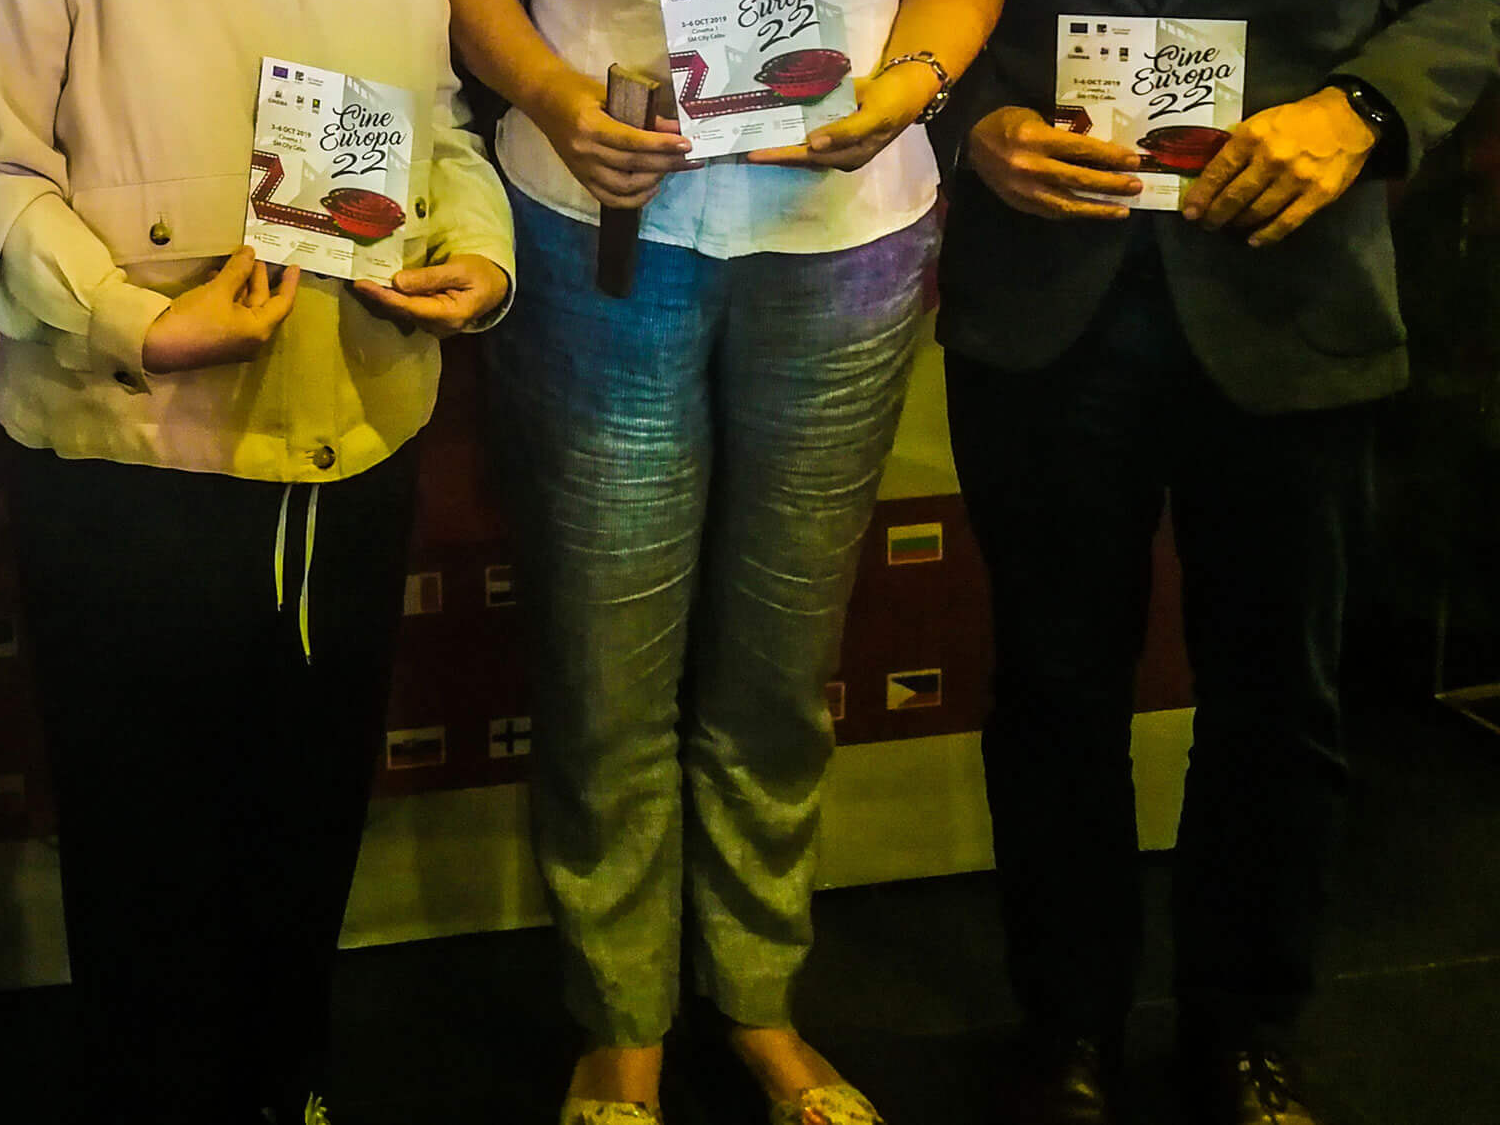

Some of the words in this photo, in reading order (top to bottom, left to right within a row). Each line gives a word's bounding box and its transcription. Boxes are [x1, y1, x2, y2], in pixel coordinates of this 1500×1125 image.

[757, 4, 821, 52] 22
[1144, 44, 1220, 73] Cine
[1131, 63, 1237, 96] Europa
[1147, 85, 1217, 120] 22
[332, 103, 395, 132] Cine
[319, 123, 406, 151] Europa
[331, 150, 389, 179] 22
